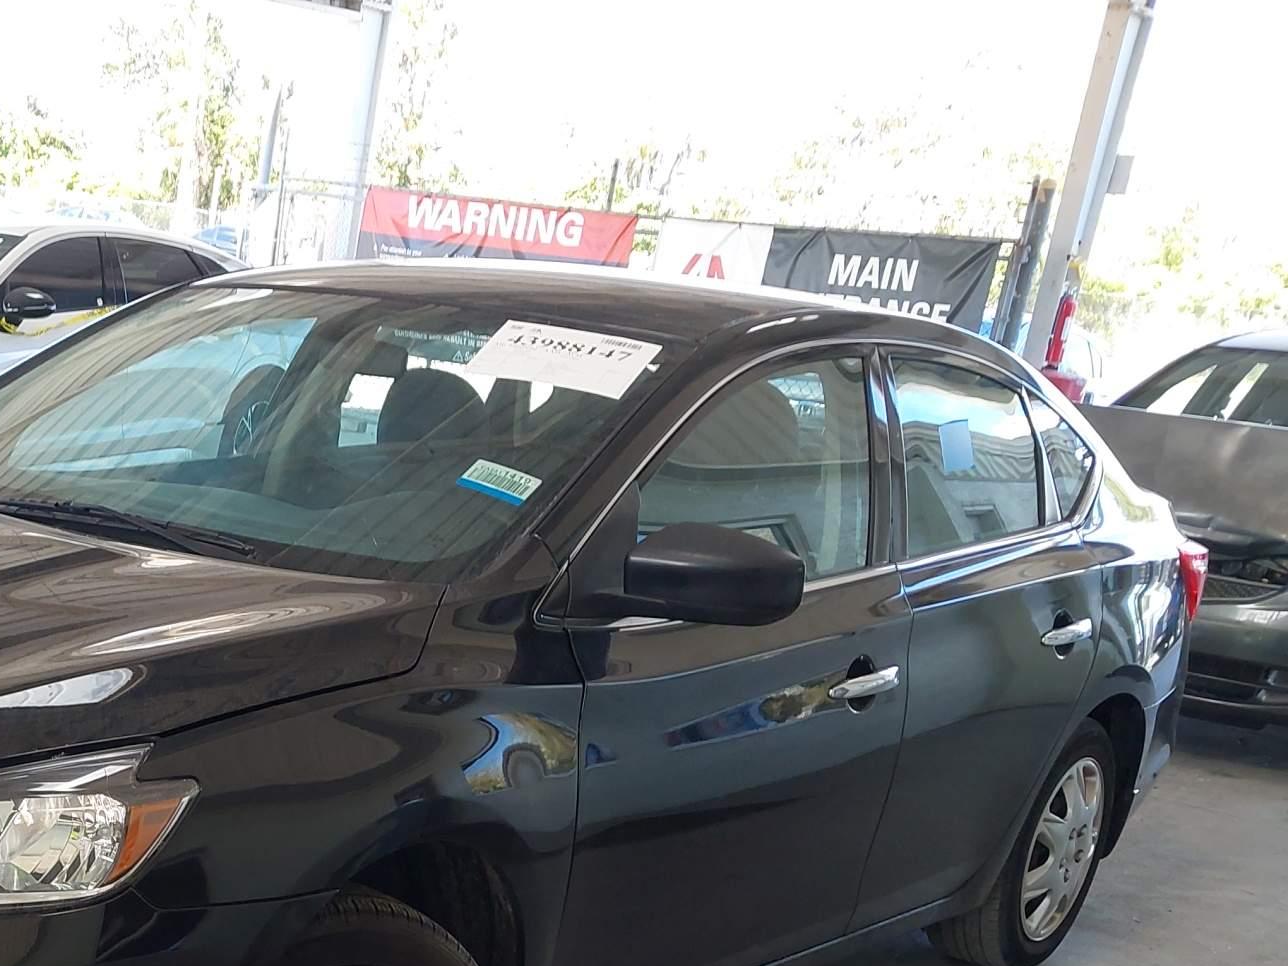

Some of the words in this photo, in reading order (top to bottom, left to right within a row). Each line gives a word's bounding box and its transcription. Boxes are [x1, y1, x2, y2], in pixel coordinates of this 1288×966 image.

[407, 195, 585, 248] WARNING
[827, 253, 919, 292] MAIN
[508, 334, 633, 361] 43988147
